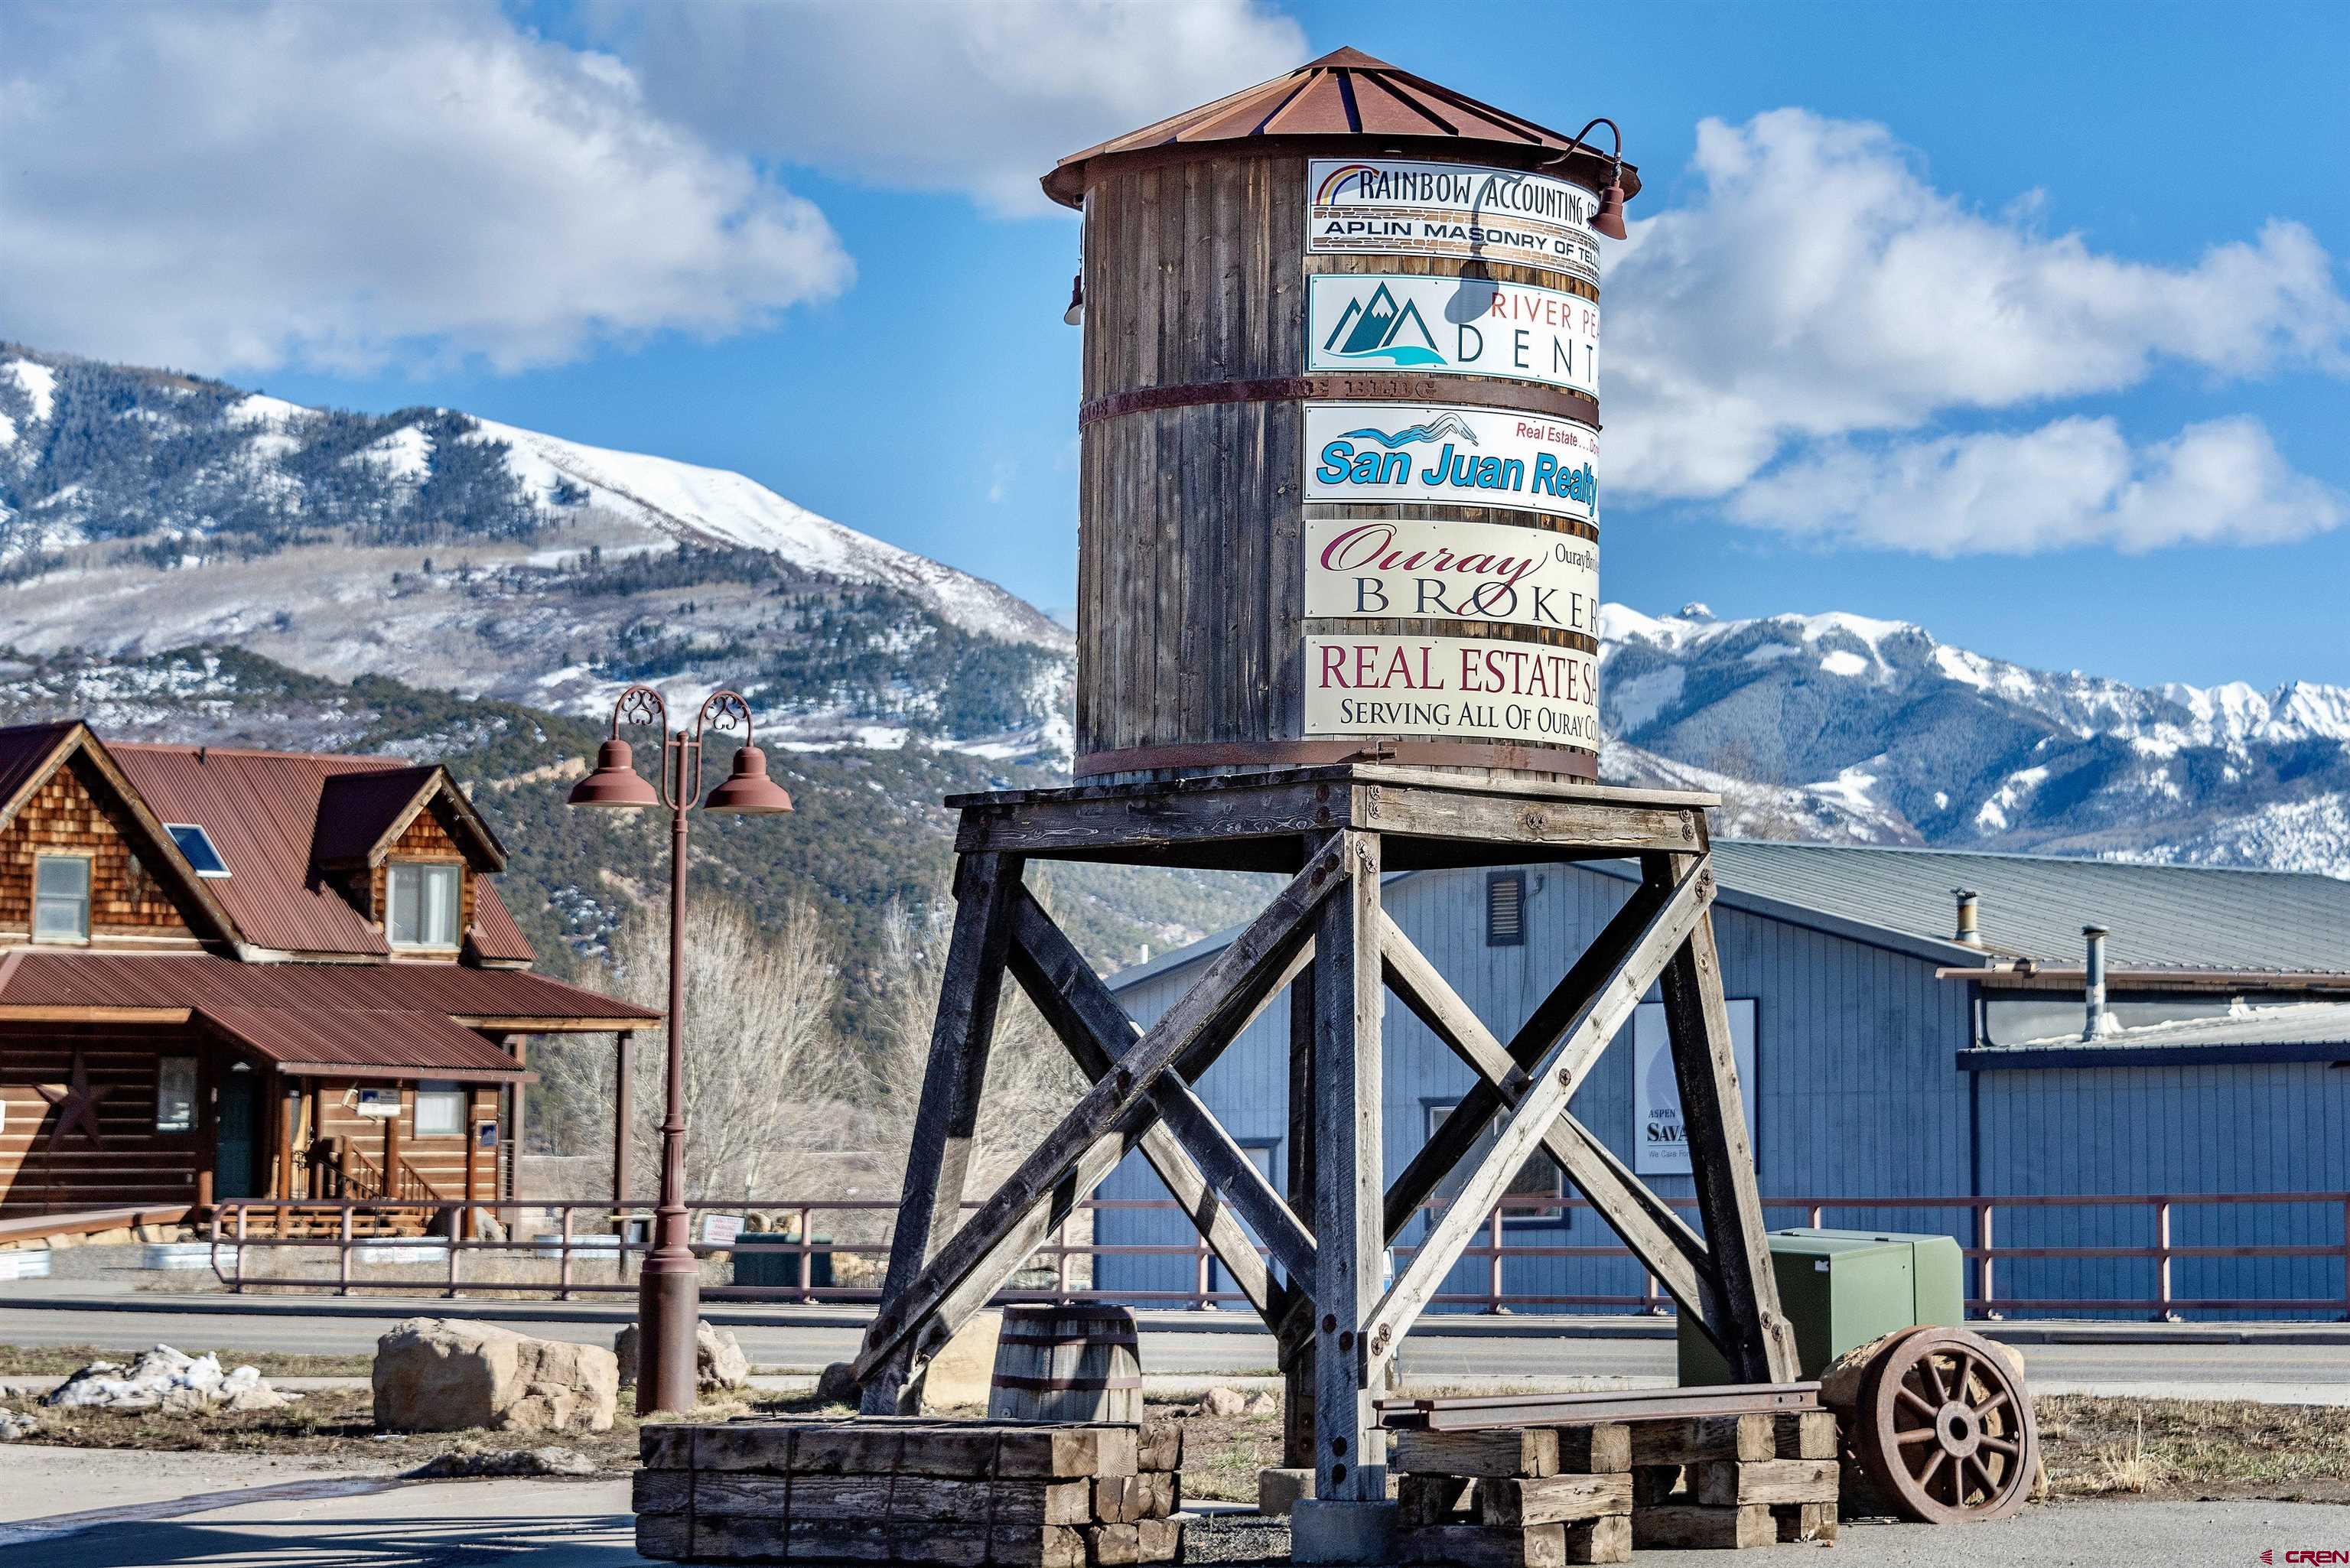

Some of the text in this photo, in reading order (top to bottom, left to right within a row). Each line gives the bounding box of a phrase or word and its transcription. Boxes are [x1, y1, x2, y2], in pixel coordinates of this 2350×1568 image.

[1359, 170, 1470, 204] RAINBOW
[1485, 176, 1583, 226] ACCOUNTING
[1325, 221, 1411, 235] APLIN
[1424, 224, 1547, 250] MASONRY
[1554, 240, 1574, 256] OF
[1492, 292, 1572, 330] RIVER
[1458, 324, 1593, 383] DENT
[1516, 421, 1544, 440] Real
[1317, 441, 1598, 517] San Juan Realty
[1320, 524, 1548, 616] Ouray
[1318, 646, 1444, 690] REAL
[1459, 648, 1578, 701] ESTATE
[1340, 698, 1450, 726] SERVING
[1458, 701, 1499, 729] ALL
[1538, 707, 1583, 737] OURAY
[1648, 1109, 1675, 1118] ASPEN
